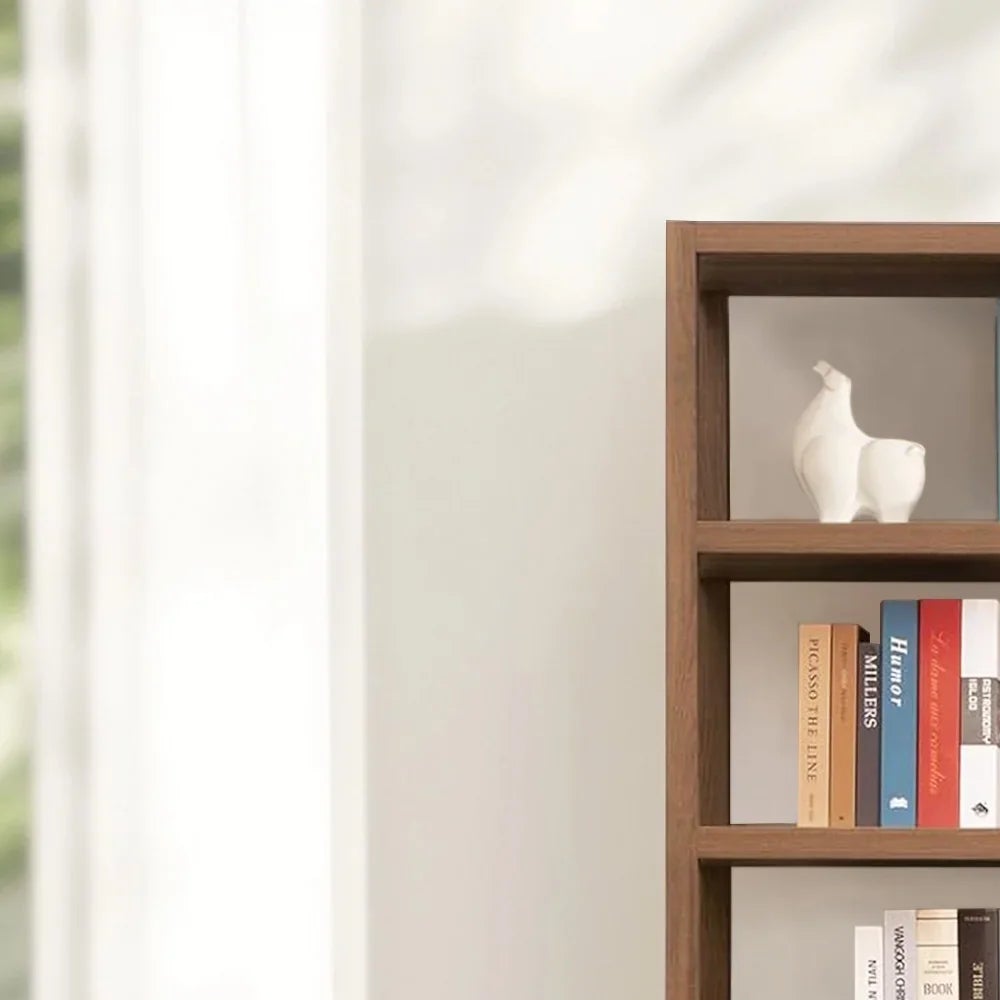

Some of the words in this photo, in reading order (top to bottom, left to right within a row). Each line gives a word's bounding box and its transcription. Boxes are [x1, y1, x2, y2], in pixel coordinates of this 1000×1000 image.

[808, 638, 820, 700] PICASSO
[889, 636, 908, 707] Humor
[863, 654, 878, 729] MILLERS
[807, 708, 818, 737] THE
[806, 745, 817, 782] LINE
[894, 925, 904, 975] VANGOGH
[868, 959, 877, 985] TIAN
[923, 982, 953, 996] BOOK
[972, 962, 984, 1000] BIBLE
